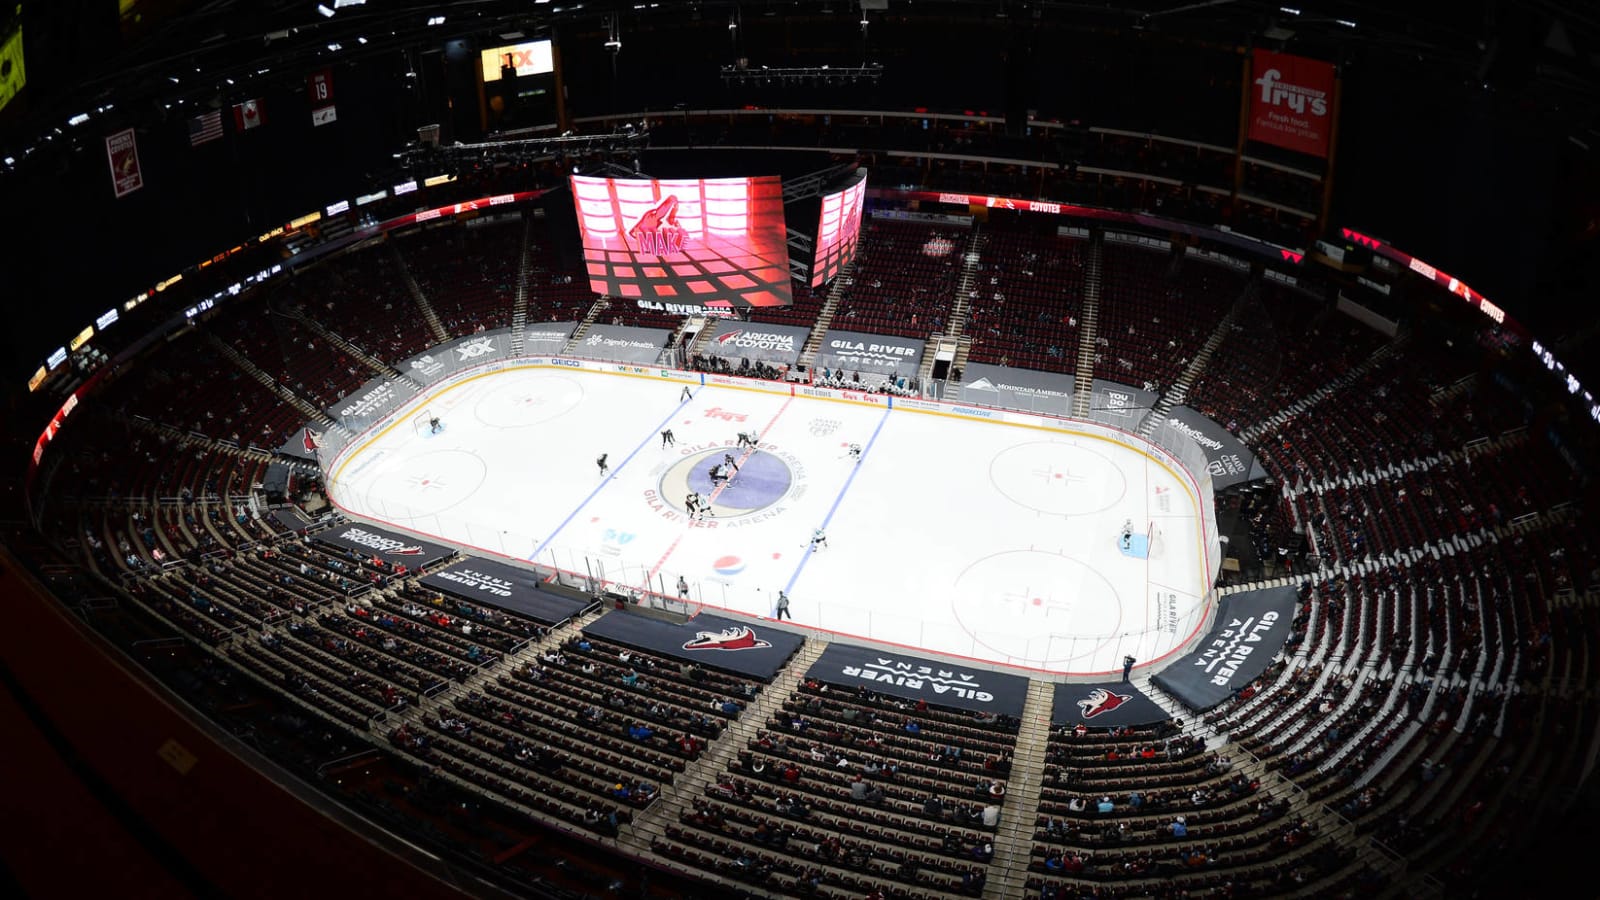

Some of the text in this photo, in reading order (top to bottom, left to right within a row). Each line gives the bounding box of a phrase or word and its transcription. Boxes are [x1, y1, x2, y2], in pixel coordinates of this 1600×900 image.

[316, 82, 328, 100] 19
[1256, 69, 1326, 116] fry's
[1268, 112, 1288, 123] Fresh
[1030, 201, 1060, 214] COYOTES
[637, 300, 664, 311] GILA
[666, 302, 701, 314] RIVER
[1480, 298, 1504, 324] COYOTES
[603, 338, 654, 349] Dignity Health
[735, 338, 794, 351] COYOTES
[742, 331, 794, 344] ARIZONA
[456, 339, 496, 361] XX
[831, 340, 916, 357] GILA RIVER
[552, 359, 580, 367] GEICO
[838, 356, 896, 367] ARENA
[997, 383, 1068, 398] MOUNTAIN AMERICA
[1109, 392, 1128, 401] YOU
[1177, 422, 1224, 450] MedSupply
[680, 441, 718, 455] GILA
[724, 440, 778, 452] RER
[1220, 454, 1238, 476] CLINIC
[1230, 454, 1246, 472] MAYO
[643, 489, 664, 512] GILA
[727, 506, 788, 528] ARENA
[340, 531, 394, 551] ARIZONA
[350, 528, 404, 548] COYOTES
[436, 572, 512, 596] GILA RIVER
[464, 569, 512, 586] ARENA
[1169, 594, 1177, 610] GILA
[1195, 618, 1241, 666] ARENA
[1210, 610, 1279, 686] GILA RIVER
[877, 657, 974, 681] ARENA
[842, 665, 994, 702] GILA RIVER
